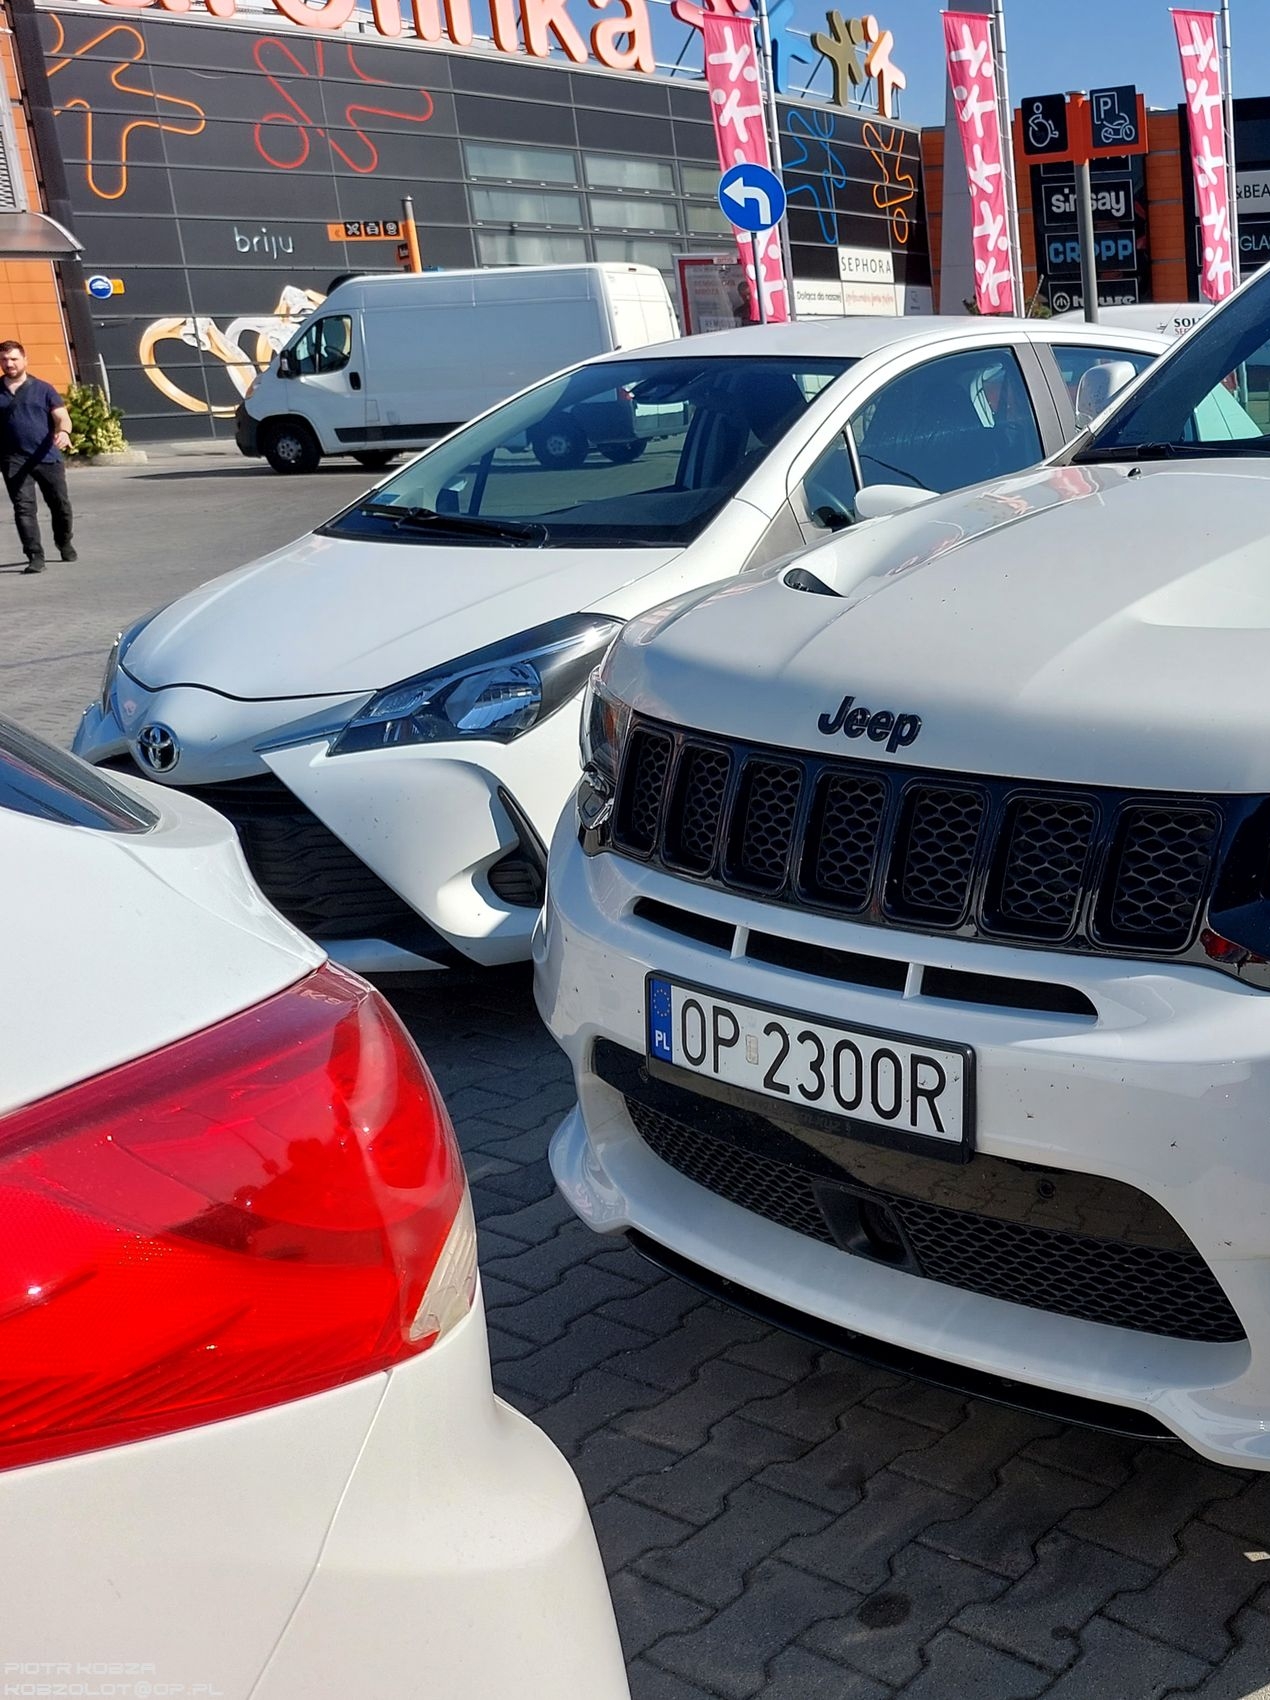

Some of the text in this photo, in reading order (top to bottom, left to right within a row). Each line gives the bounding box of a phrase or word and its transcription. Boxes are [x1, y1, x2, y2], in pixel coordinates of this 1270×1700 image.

[1100, 97, 1111, 119] P
[233, 226, 294, 260] briju
[1050, 239, 1132, 263] CRPP
[841, 256, 892, 274] SEPHORA
[1072, 295, 1136, 307] huse
[816, 695, 922, 753] Jeep
[655, 1030, 671, 1051] PL
[681, 998, 947, 1134] OP 2300R
